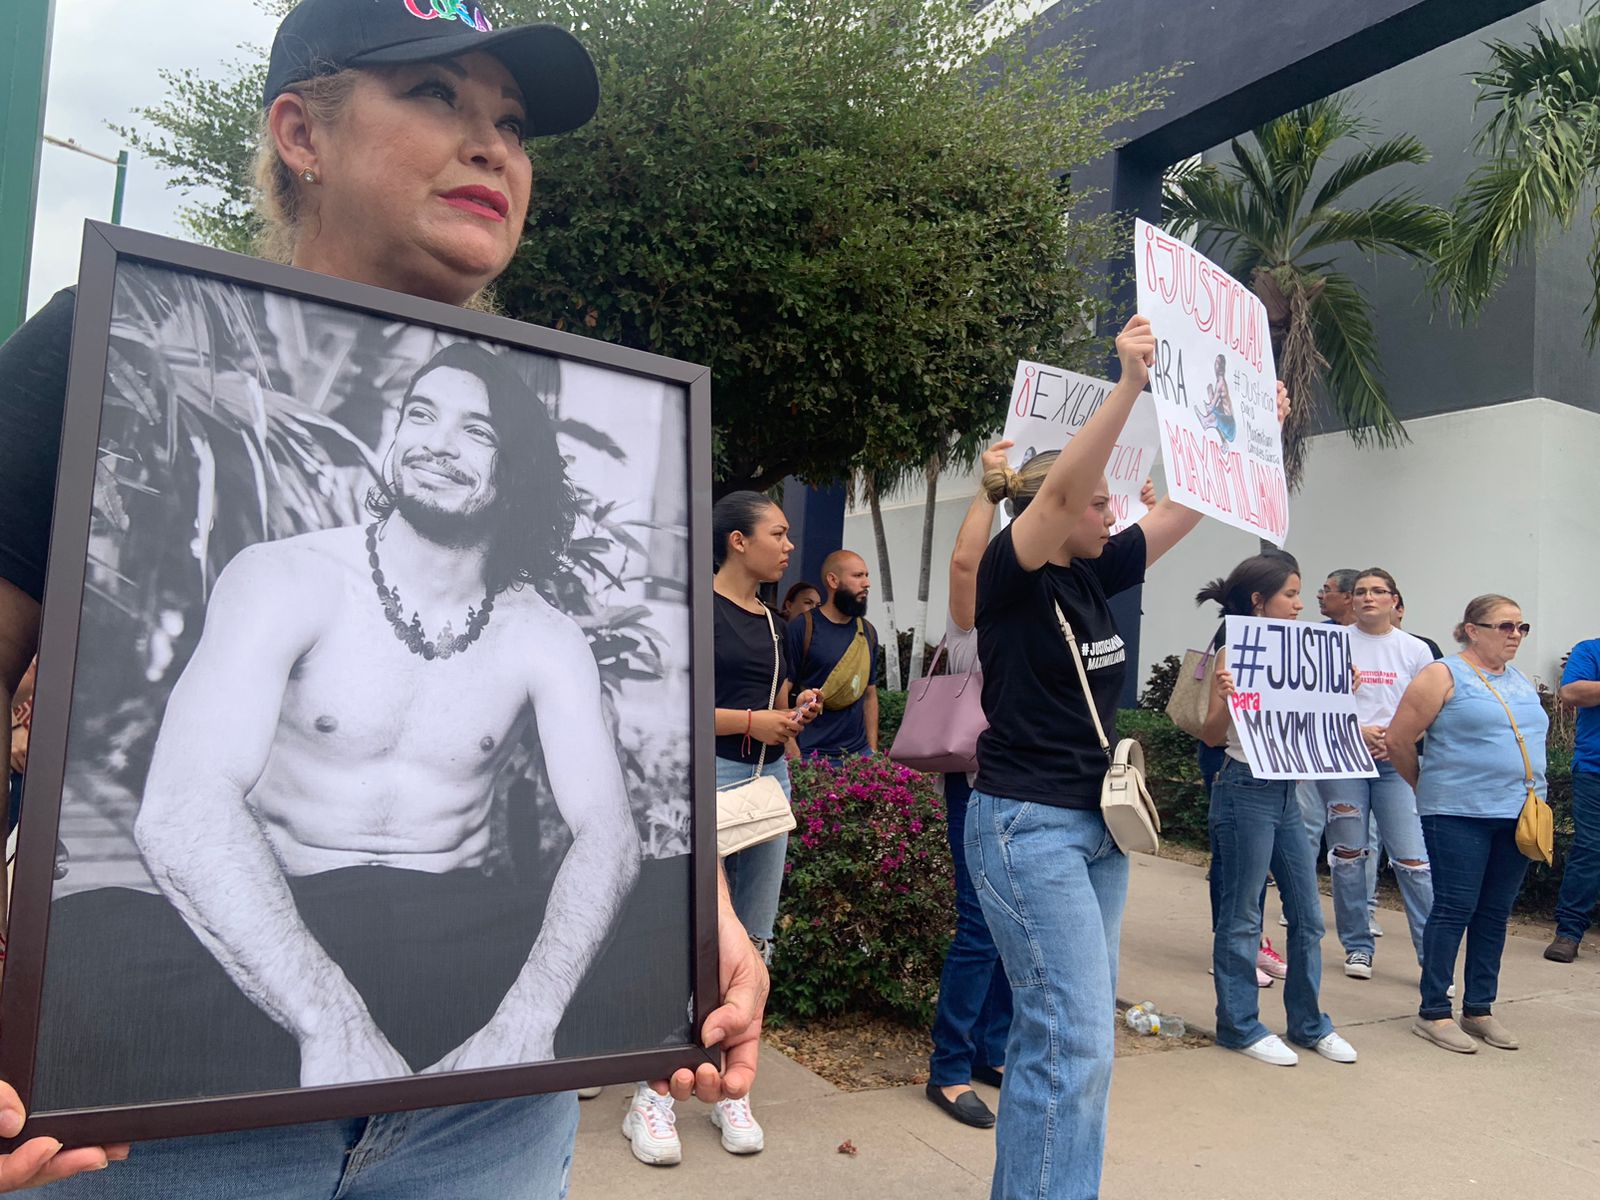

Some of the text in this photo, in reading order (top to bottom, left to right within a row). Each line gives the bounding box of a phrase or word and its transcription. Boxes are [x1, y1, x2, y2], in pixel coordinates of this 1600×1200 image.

[1145, 225, 1263, 373] ¡JUSTICIA!
[1154, 338, 1189, 408] ARA
[1231, 625, 1353, 694] #JUSTICIA
[1232, 692, 1261, 722] para
[1243, 710, 1374, 774] MAXIMILIANO
